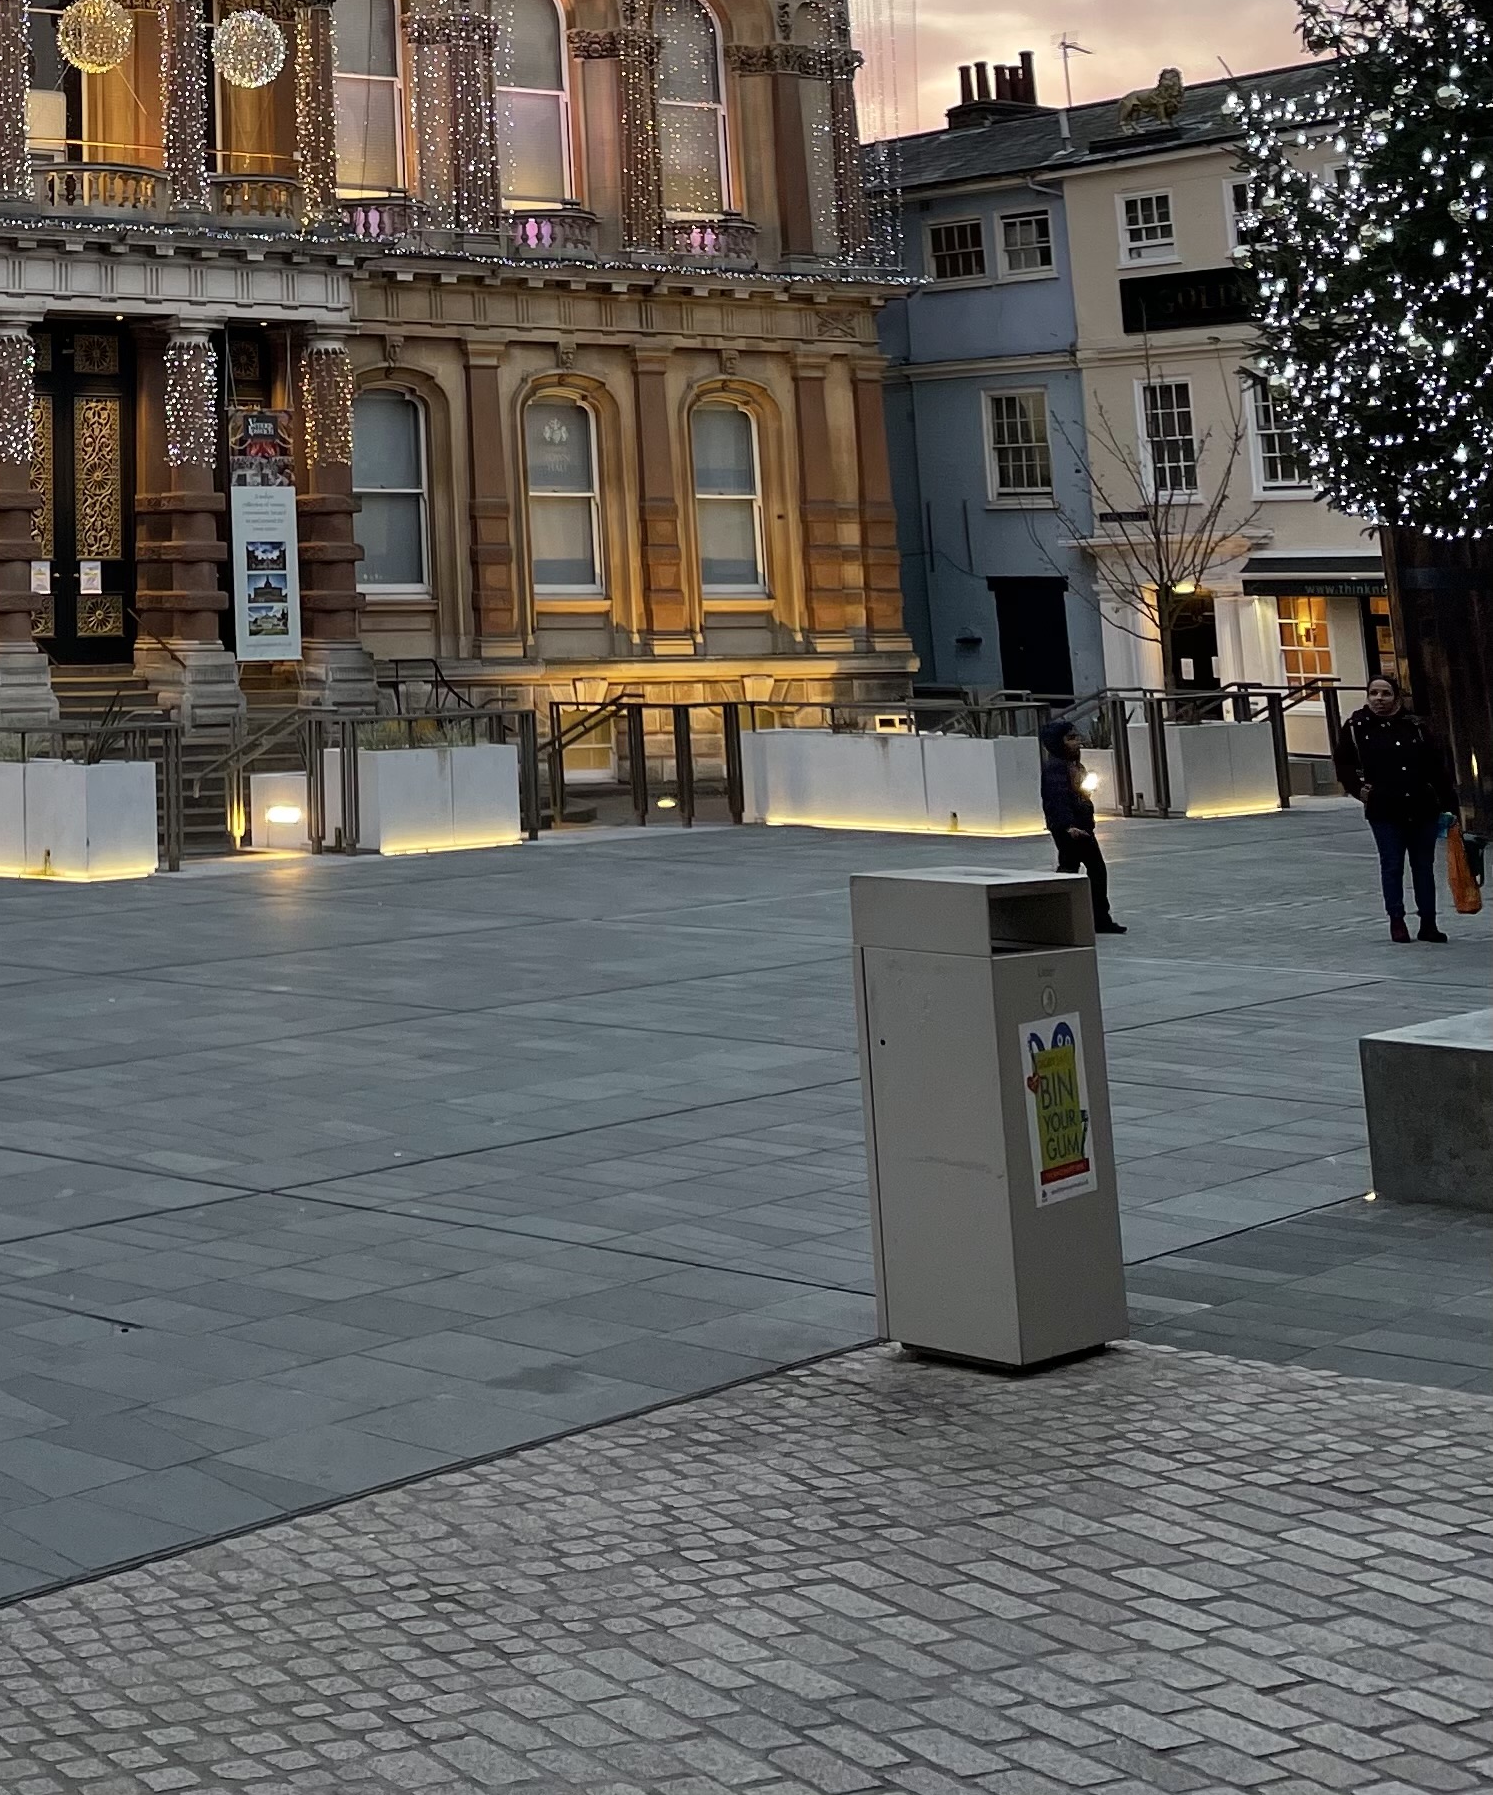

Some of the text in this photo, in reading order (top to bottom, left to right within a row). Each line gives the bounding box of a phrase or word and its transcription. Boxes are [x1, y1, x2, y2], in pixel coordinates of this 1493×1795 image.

[1041, 1069, 1074, 1110] BIN
[1043, 1109, 1077, 1135] YOUR
[1047, 1133, 1080, 1160] GUM
